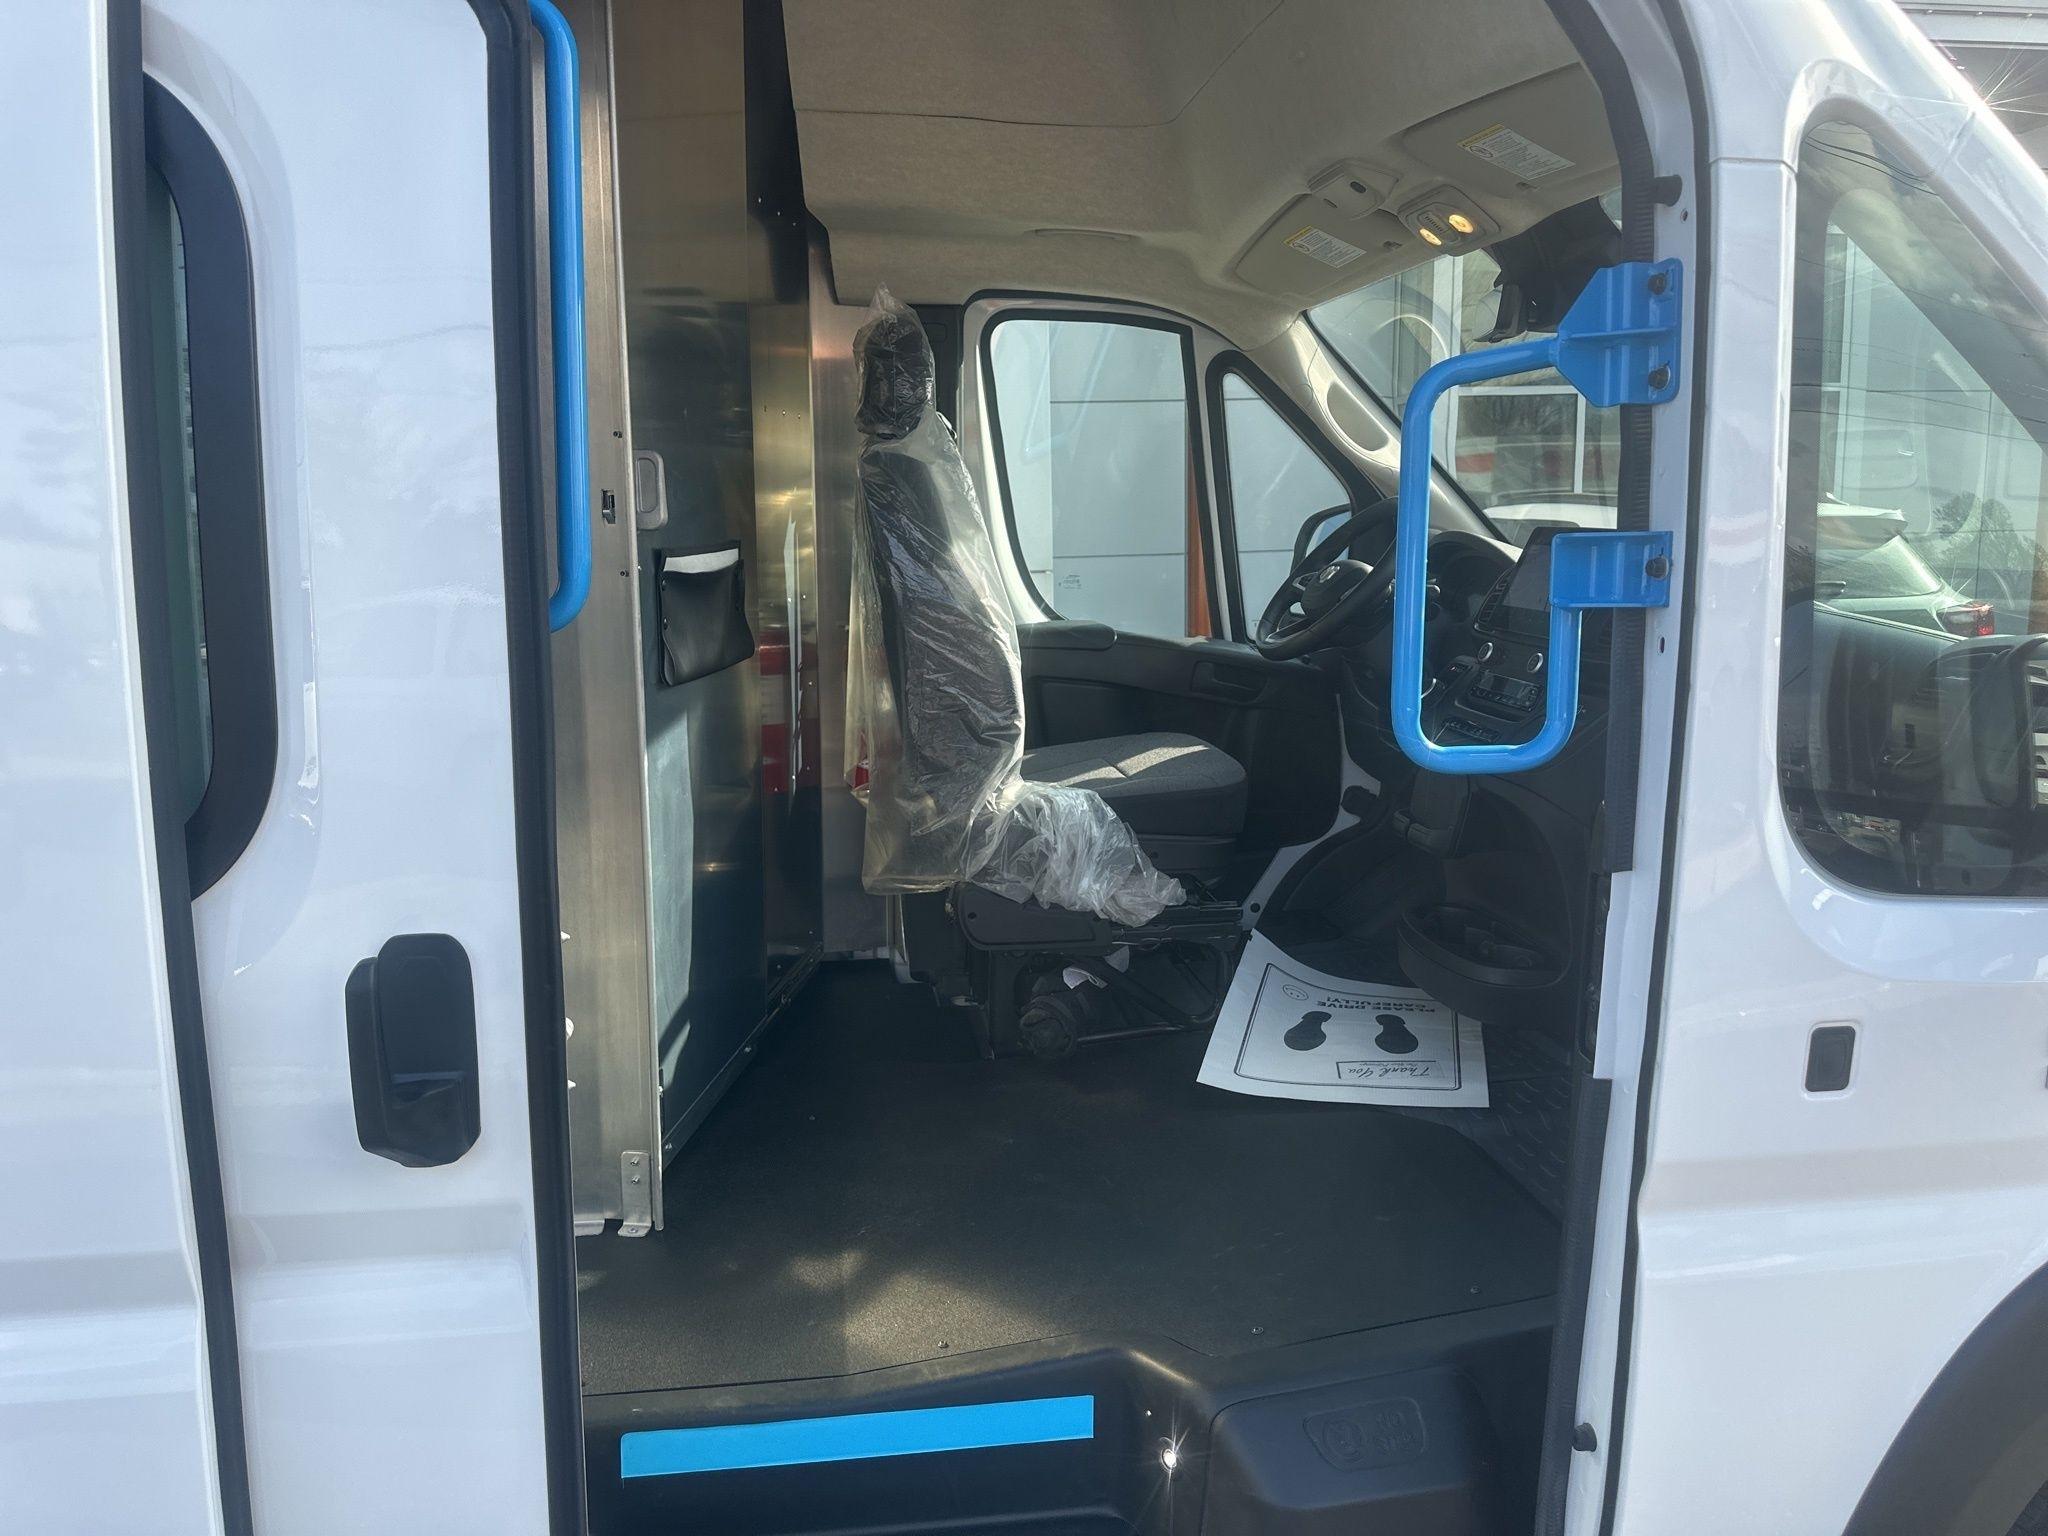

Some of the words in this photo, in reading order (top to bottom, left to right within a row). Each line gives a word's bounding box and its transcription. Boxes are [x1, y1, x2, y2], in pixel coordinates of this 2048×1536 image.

[1317, 1000, 1366, 1010] DRIVE
[1371, 1005, 1436, 1013] PLEASE
[1348, 1067, 1374, 1078] You
[1378, 1066, 1430, 1077] Thank
